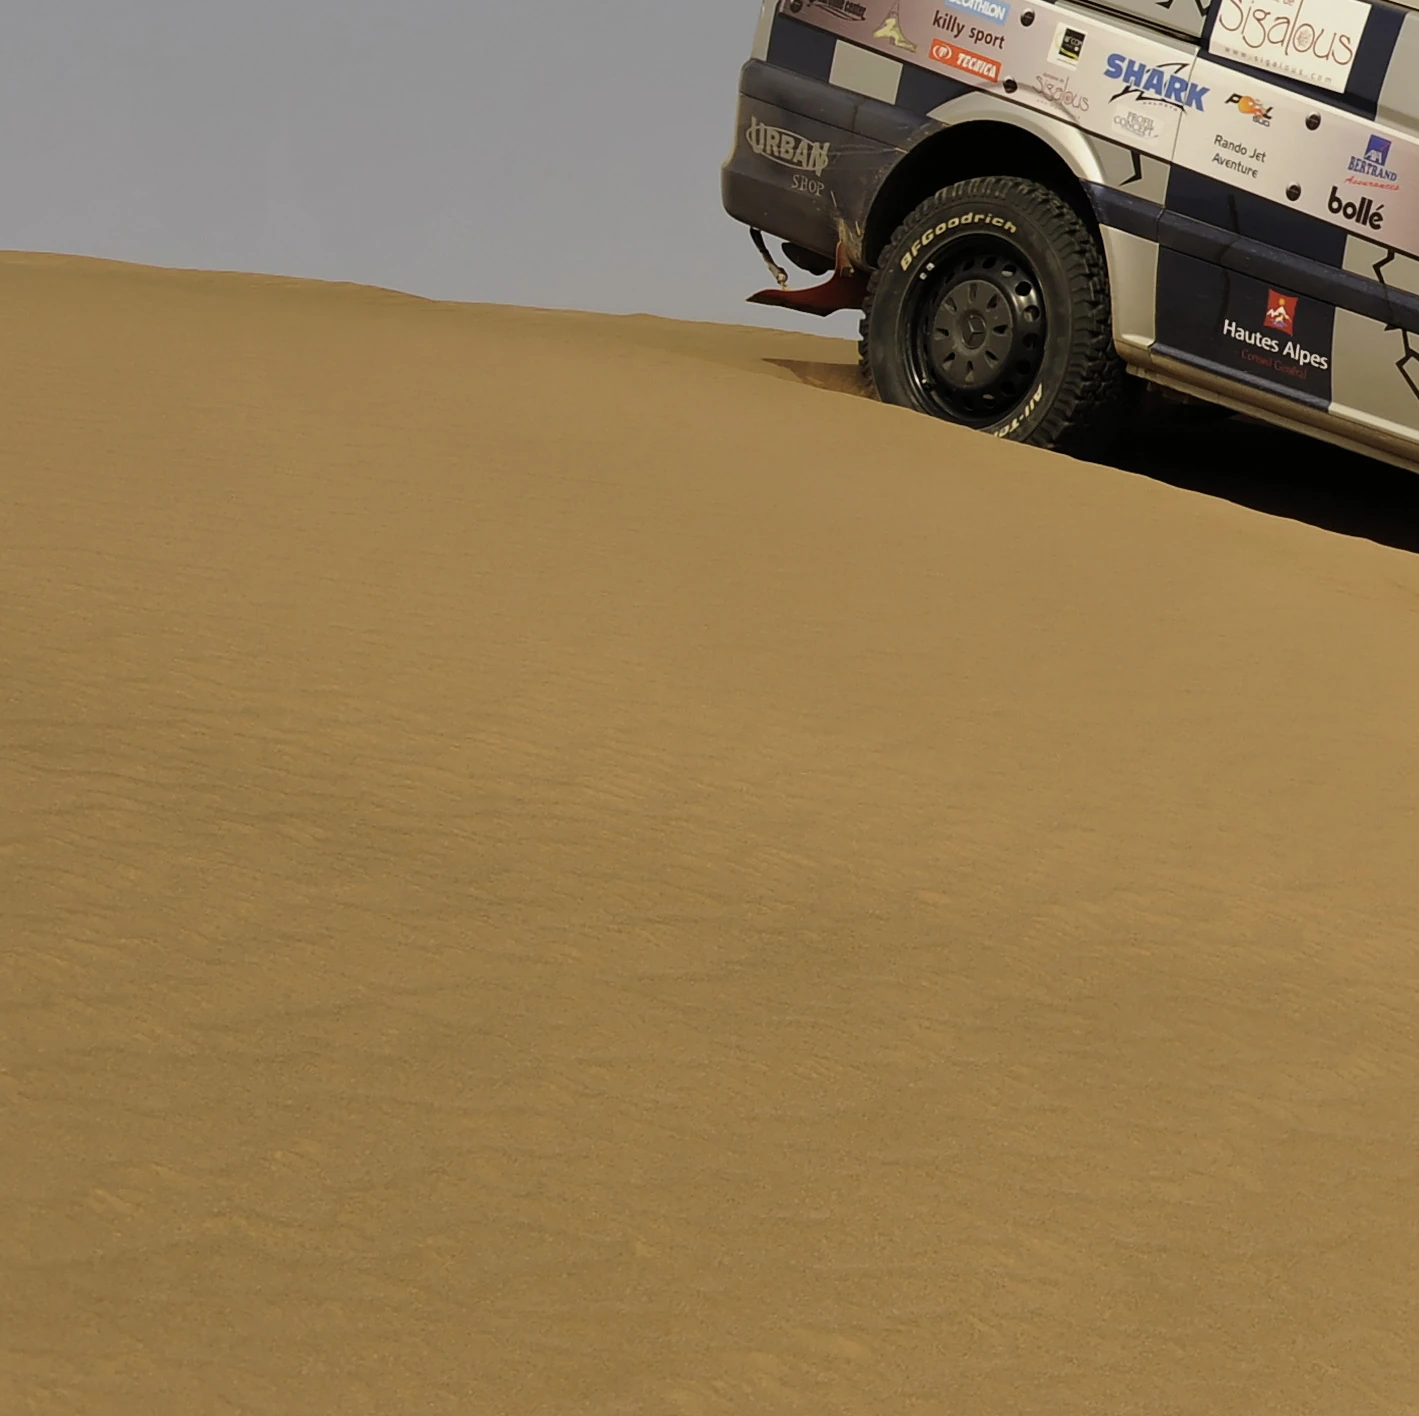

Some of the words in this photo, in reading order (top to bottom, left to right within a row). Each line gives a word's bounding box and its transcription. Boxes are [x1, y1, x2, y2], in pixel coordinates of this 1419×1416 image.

[932, 9, 966, 39] killy
[968, 26, 1006, 50] sport
[956, 52, 998, 79] TECNICA
[1103, 52, 1211, 112] SHARK
[749, 116, 831, 176] URBAN
[1211, 152, 1259, 179] Aventure
[1212, 134, 1248, 156] Rando
[1249, 145, 1267, 164] Jet
[791, 173, 825, 198] SHOP
[1347, 156, 1398, 182] BERTRAND
[1327, 185, 1385, 231] bollé
[900, 211, 1018, 272] BFGoodrich
[1222, 318, 1280, 354] Hautes
[1282, 340, 1329, 371] Alpes
